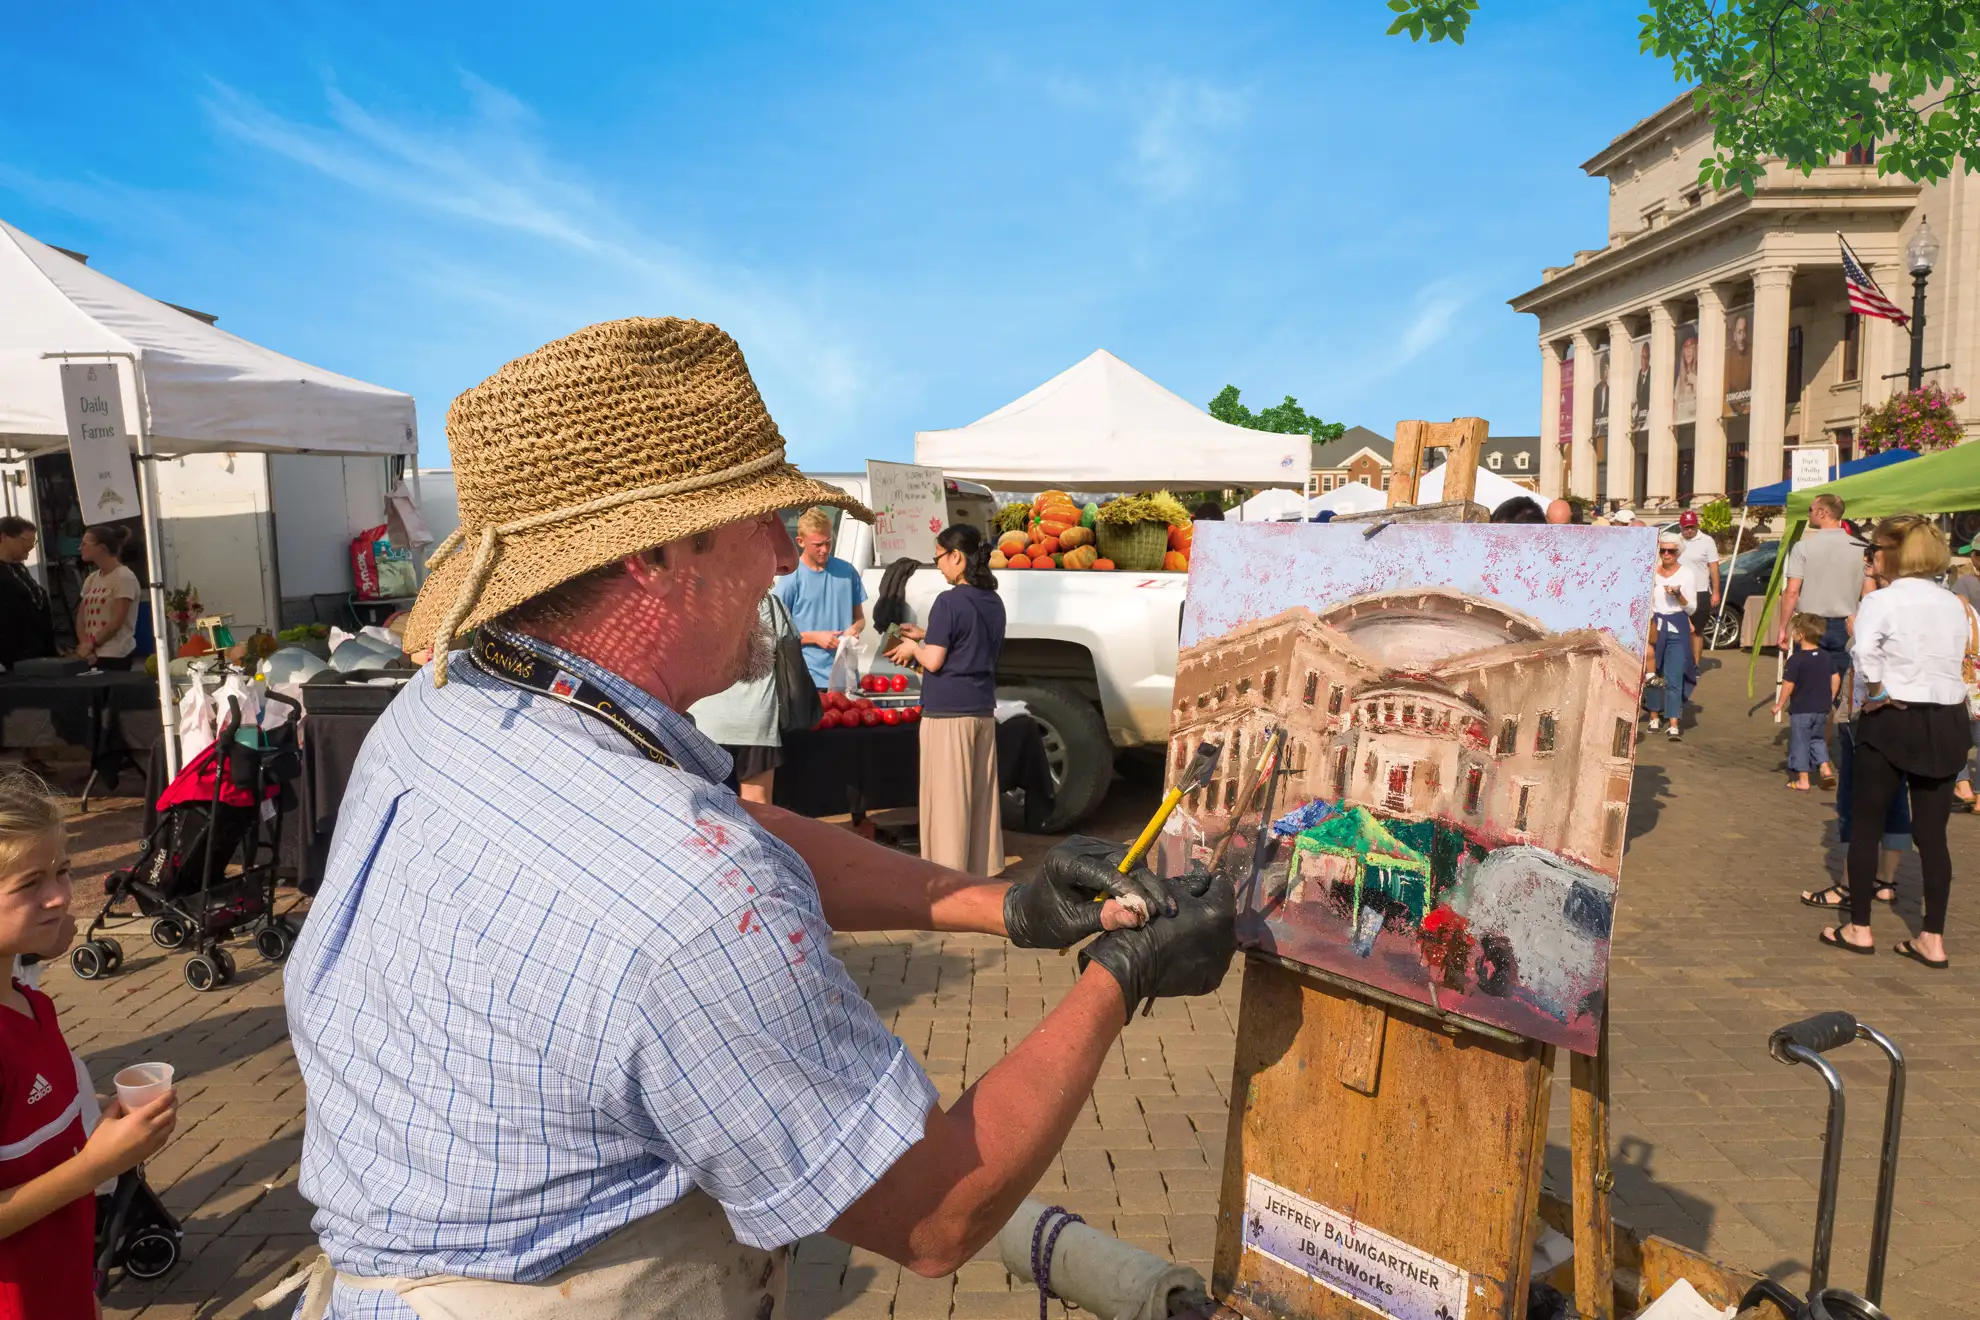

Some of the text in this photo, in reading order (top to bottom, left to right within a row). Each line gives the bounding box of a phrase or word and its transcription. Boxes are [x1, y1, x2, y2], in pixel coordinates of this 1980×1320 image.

[80, 396, 109, 416] Daily
[81, 424, 115, 440] Farms
[485, 641, 531, 679] CANVAS
[1264, 1195, 1440, 1291] JEFFREY BAUMGARTNER
